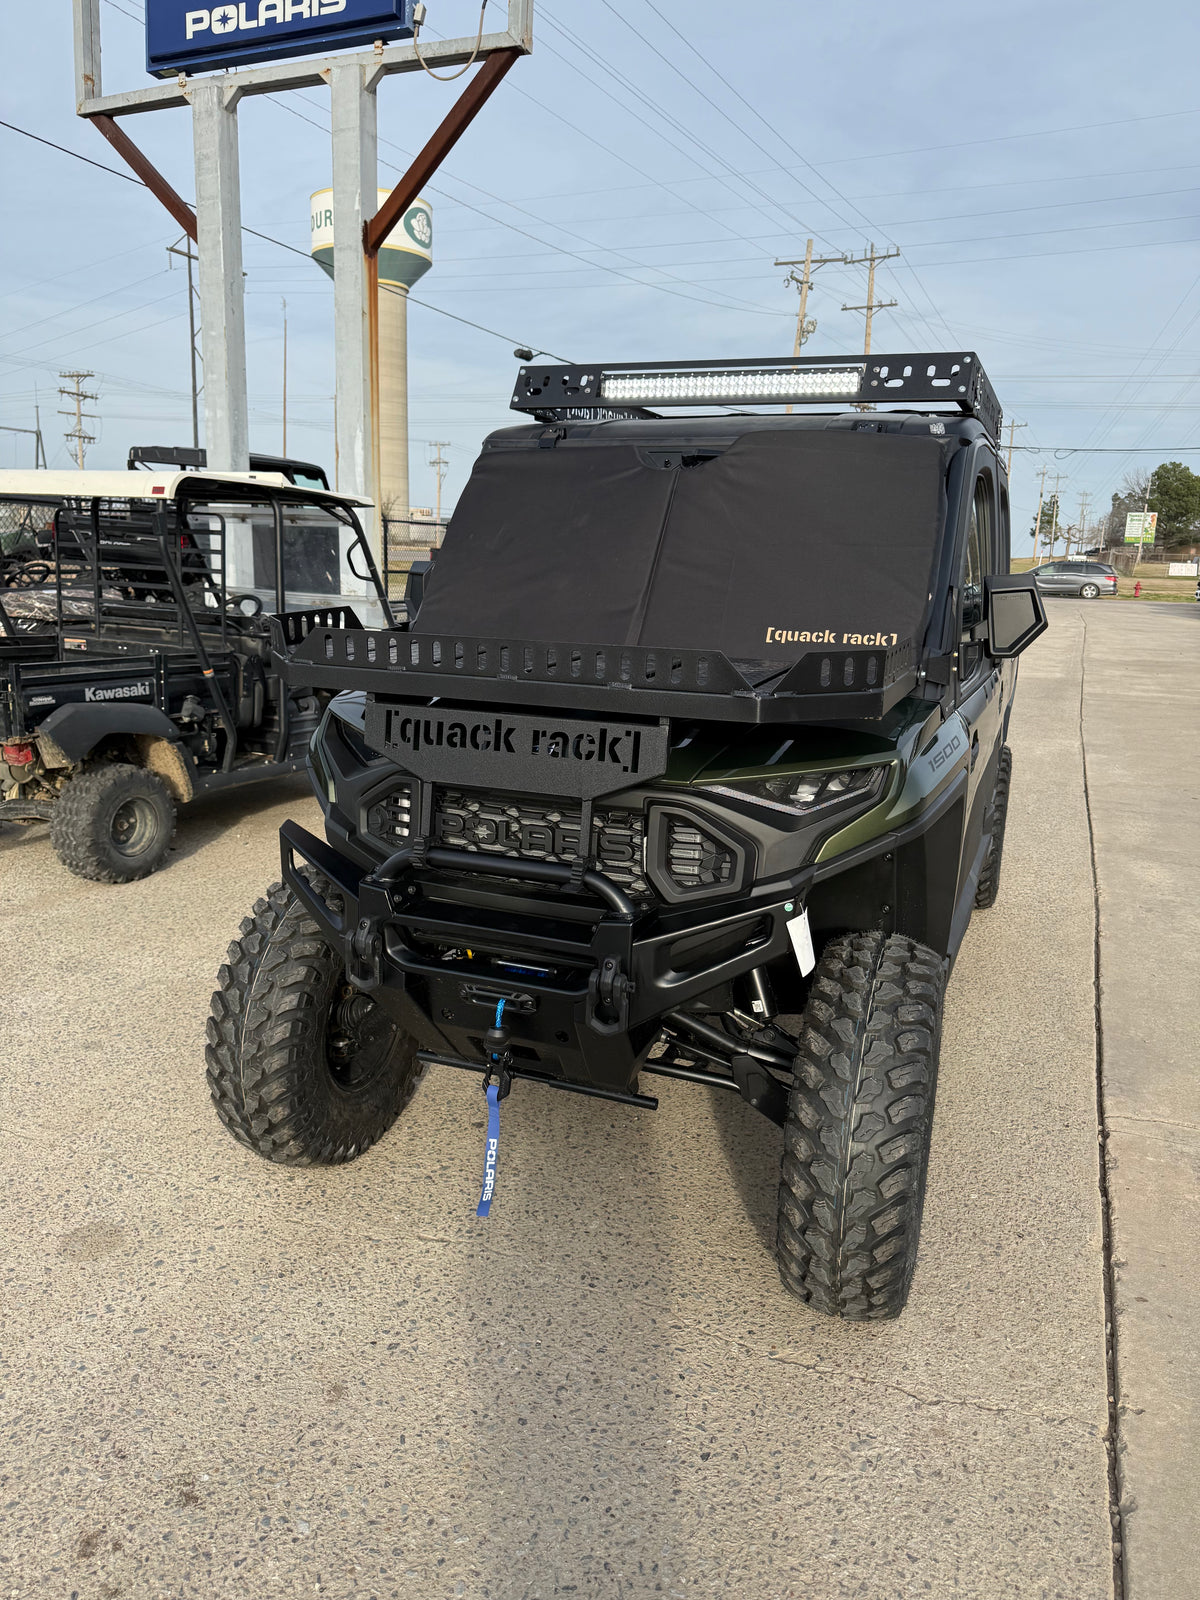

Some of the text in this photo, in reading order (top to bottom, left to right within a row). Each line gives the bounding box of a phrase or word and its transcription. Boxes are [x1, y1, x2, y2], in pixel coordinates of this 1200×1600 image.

[185, 0, 347, 40] POLARIS
[84, 682, 150, 701] Kawasaki
[927, 735, 961, 772] 1500
[482, 1138, 498, 1201] POLARIS
